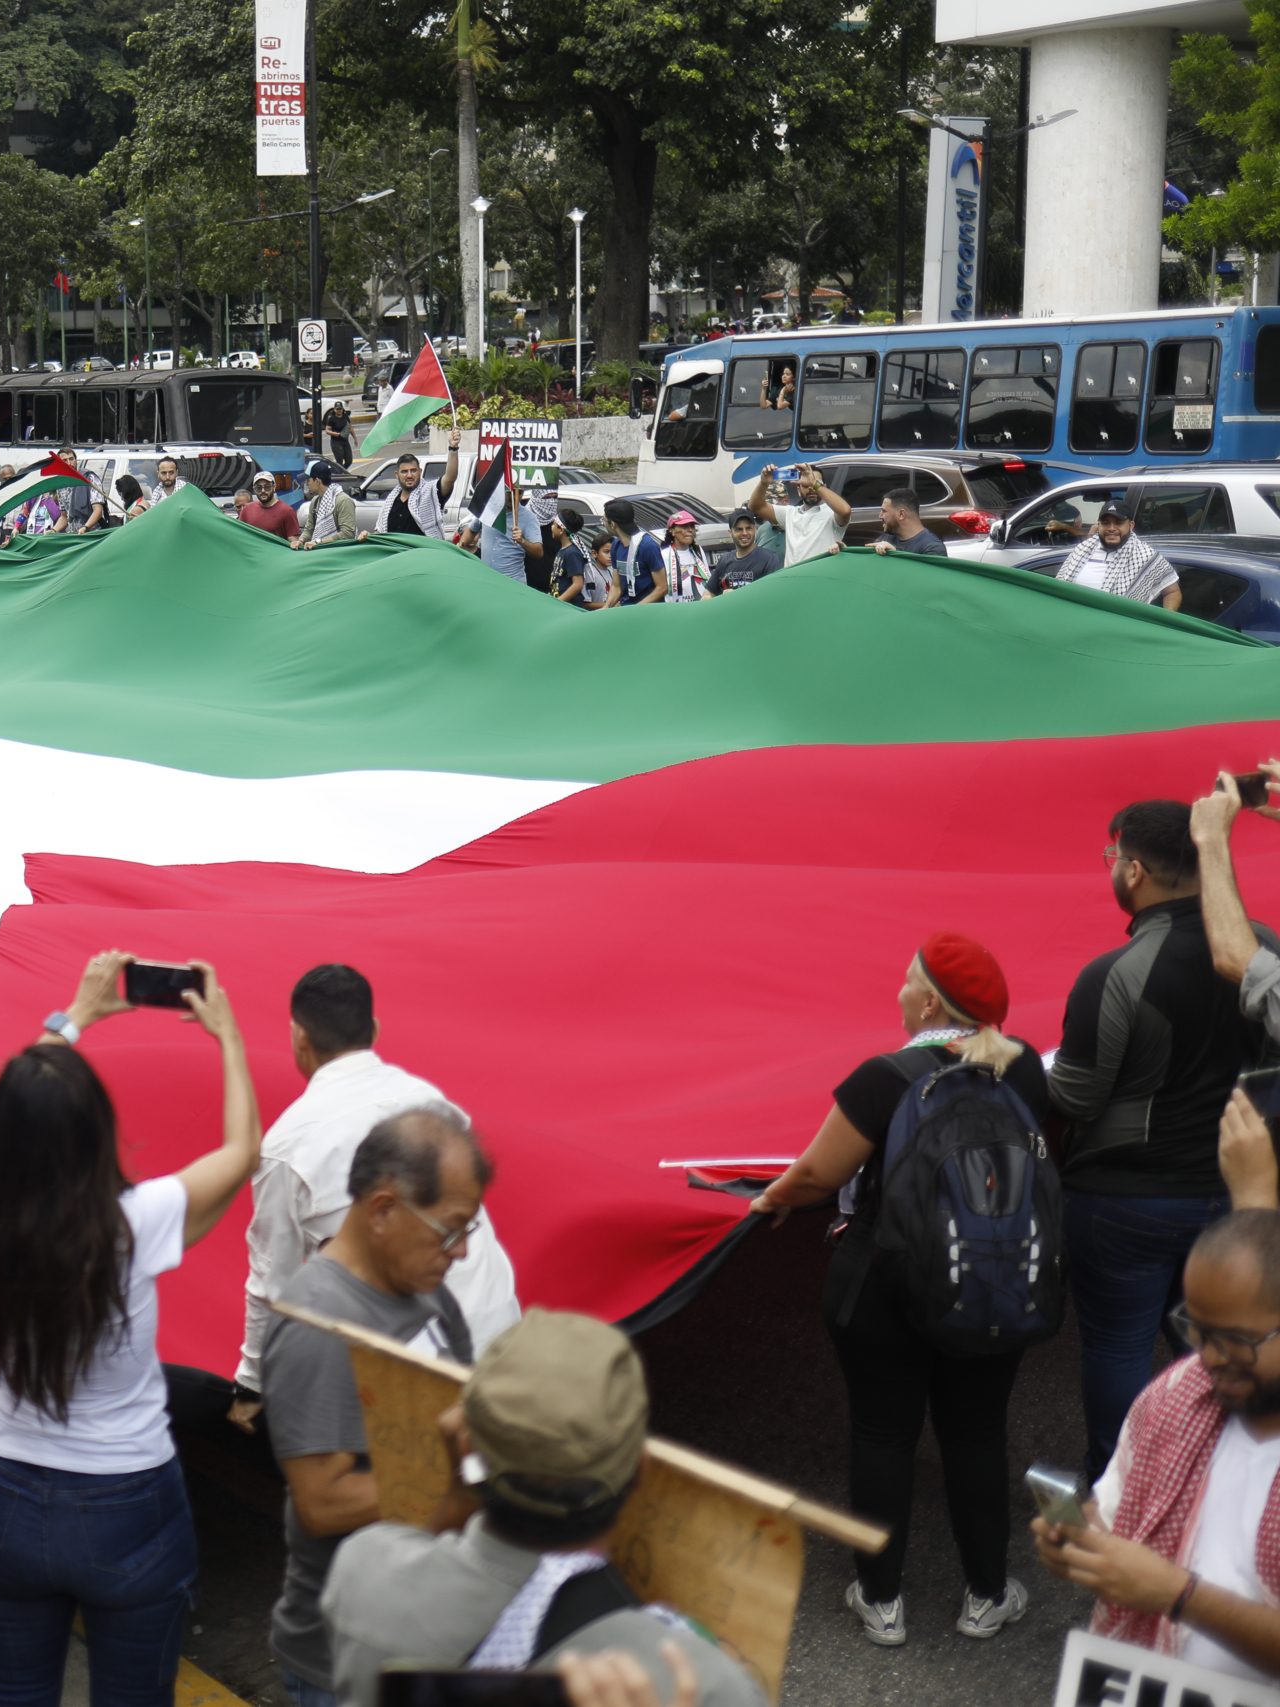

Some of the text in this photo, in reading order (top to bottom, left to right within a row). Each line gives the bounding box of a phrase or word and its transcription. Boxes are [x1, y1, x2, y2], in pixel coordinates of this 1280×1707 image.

[261, 56, 287, 69] Re-
[261, 72, 301, 81] abrimos
[261, 84, 301, 96] nues
[259, 98, 302, 115] tras
[261, 118, 301, 126] puertas
[482, 421, 559, 439] PALESTINA
[512, 445, 557, 462] ESTAS
[512, 468, 547, 487] OLA
